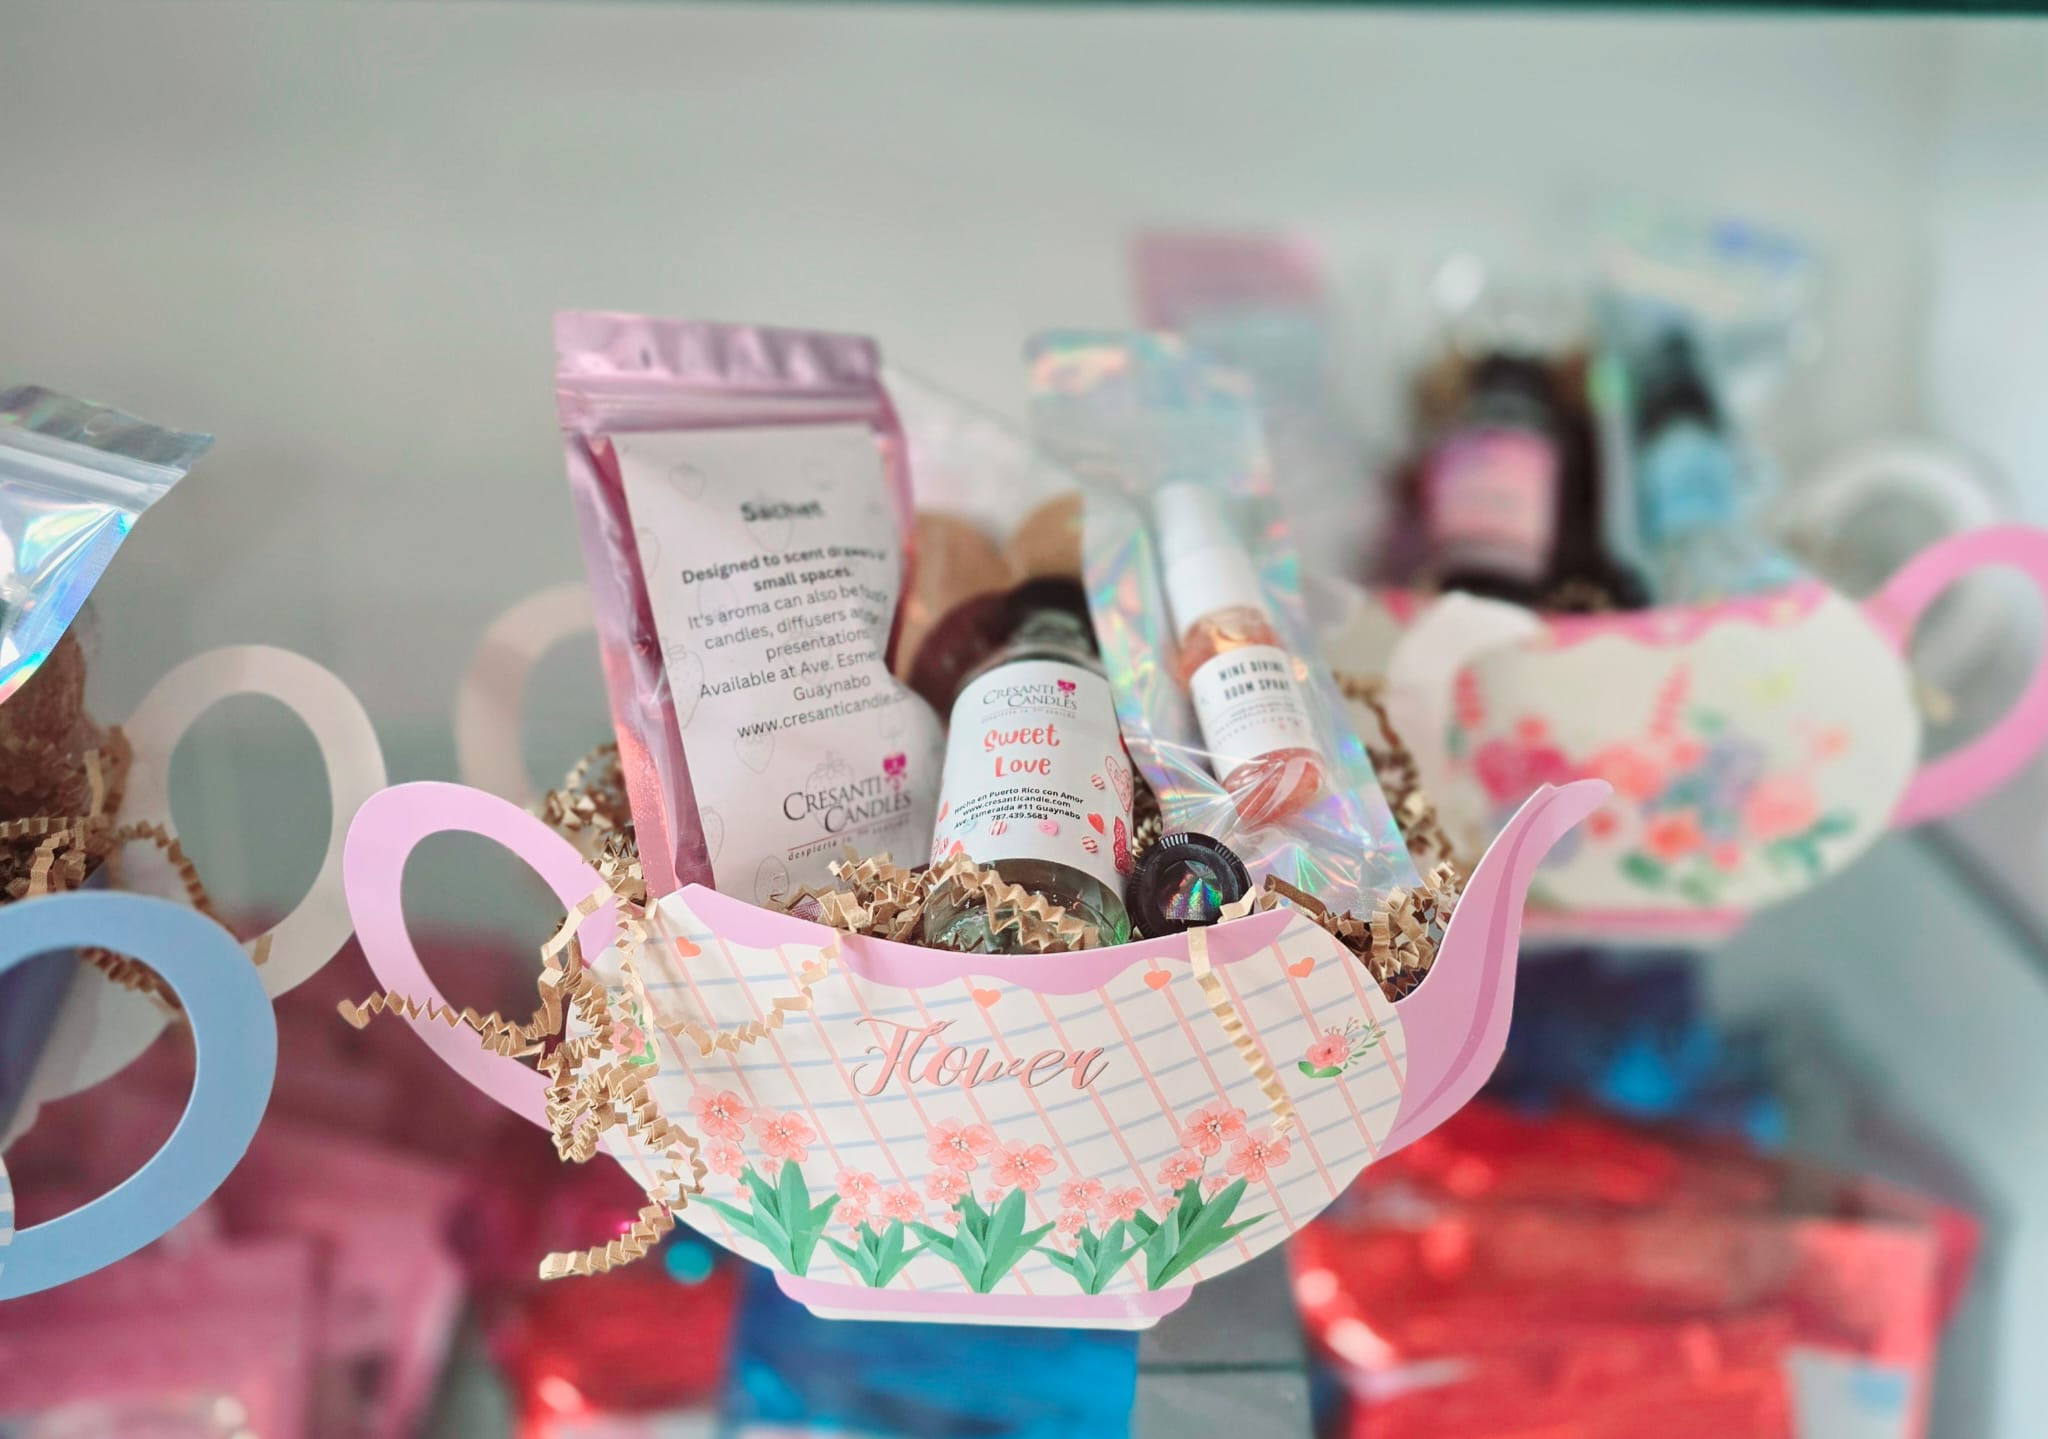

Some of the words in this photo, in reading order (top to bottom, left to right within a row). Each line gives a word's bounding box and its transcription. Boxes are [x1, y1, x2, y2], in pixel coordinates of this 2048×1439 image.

[740, 500, 822, 522] Sachet
[681, 556, 760, 586] Designed
[763, 553, 781, 568] to
[783, 547, 825, 564] scent
[753, 571, 797, 592] small
[688, 611, 714, 630] It's
[717, 600, 771, 624] aroma
[774, 594, 802, 611] can
[806, 588, 837, 605] also
[840, 584, 859, 600] be
[704, 623, 774, 651] candles,
[777, 609, 847, 633] diffusers
[699, 669, 777, 699] Available
[779, 665, 797, 682] at
[800, 657, 834, 677] Ave.
[793, 674, 872, 702] Guaynabo
[983, 684, 1054, 704] CRESANTI
[1008, 695, 1077, 710] CANDLES
[984, 723, 1060, 753] Sweet
[995, 757, 1051, 778] Love
[783, 776, 882, 821] CRESANTI
[963, 795, 1071, 816] www.cresanticandle.com
[977, 794, 987, 802] en
[989, 788, 1019, 798] Puerto
[1042, 788, 1059, 797] con
[1060, 792, 1084, 804] Amor
[825, 789, 912, 833] CANDLES
[970, 804, 1015, 820] Esmeralda
[1017, 803, 1033, 811] #11
[1036, 804, 1081, 820] Guaynabo
[991, 812, 1048, 821] 787.439.5683
[851, 1018, 1110, 1097] Flower
